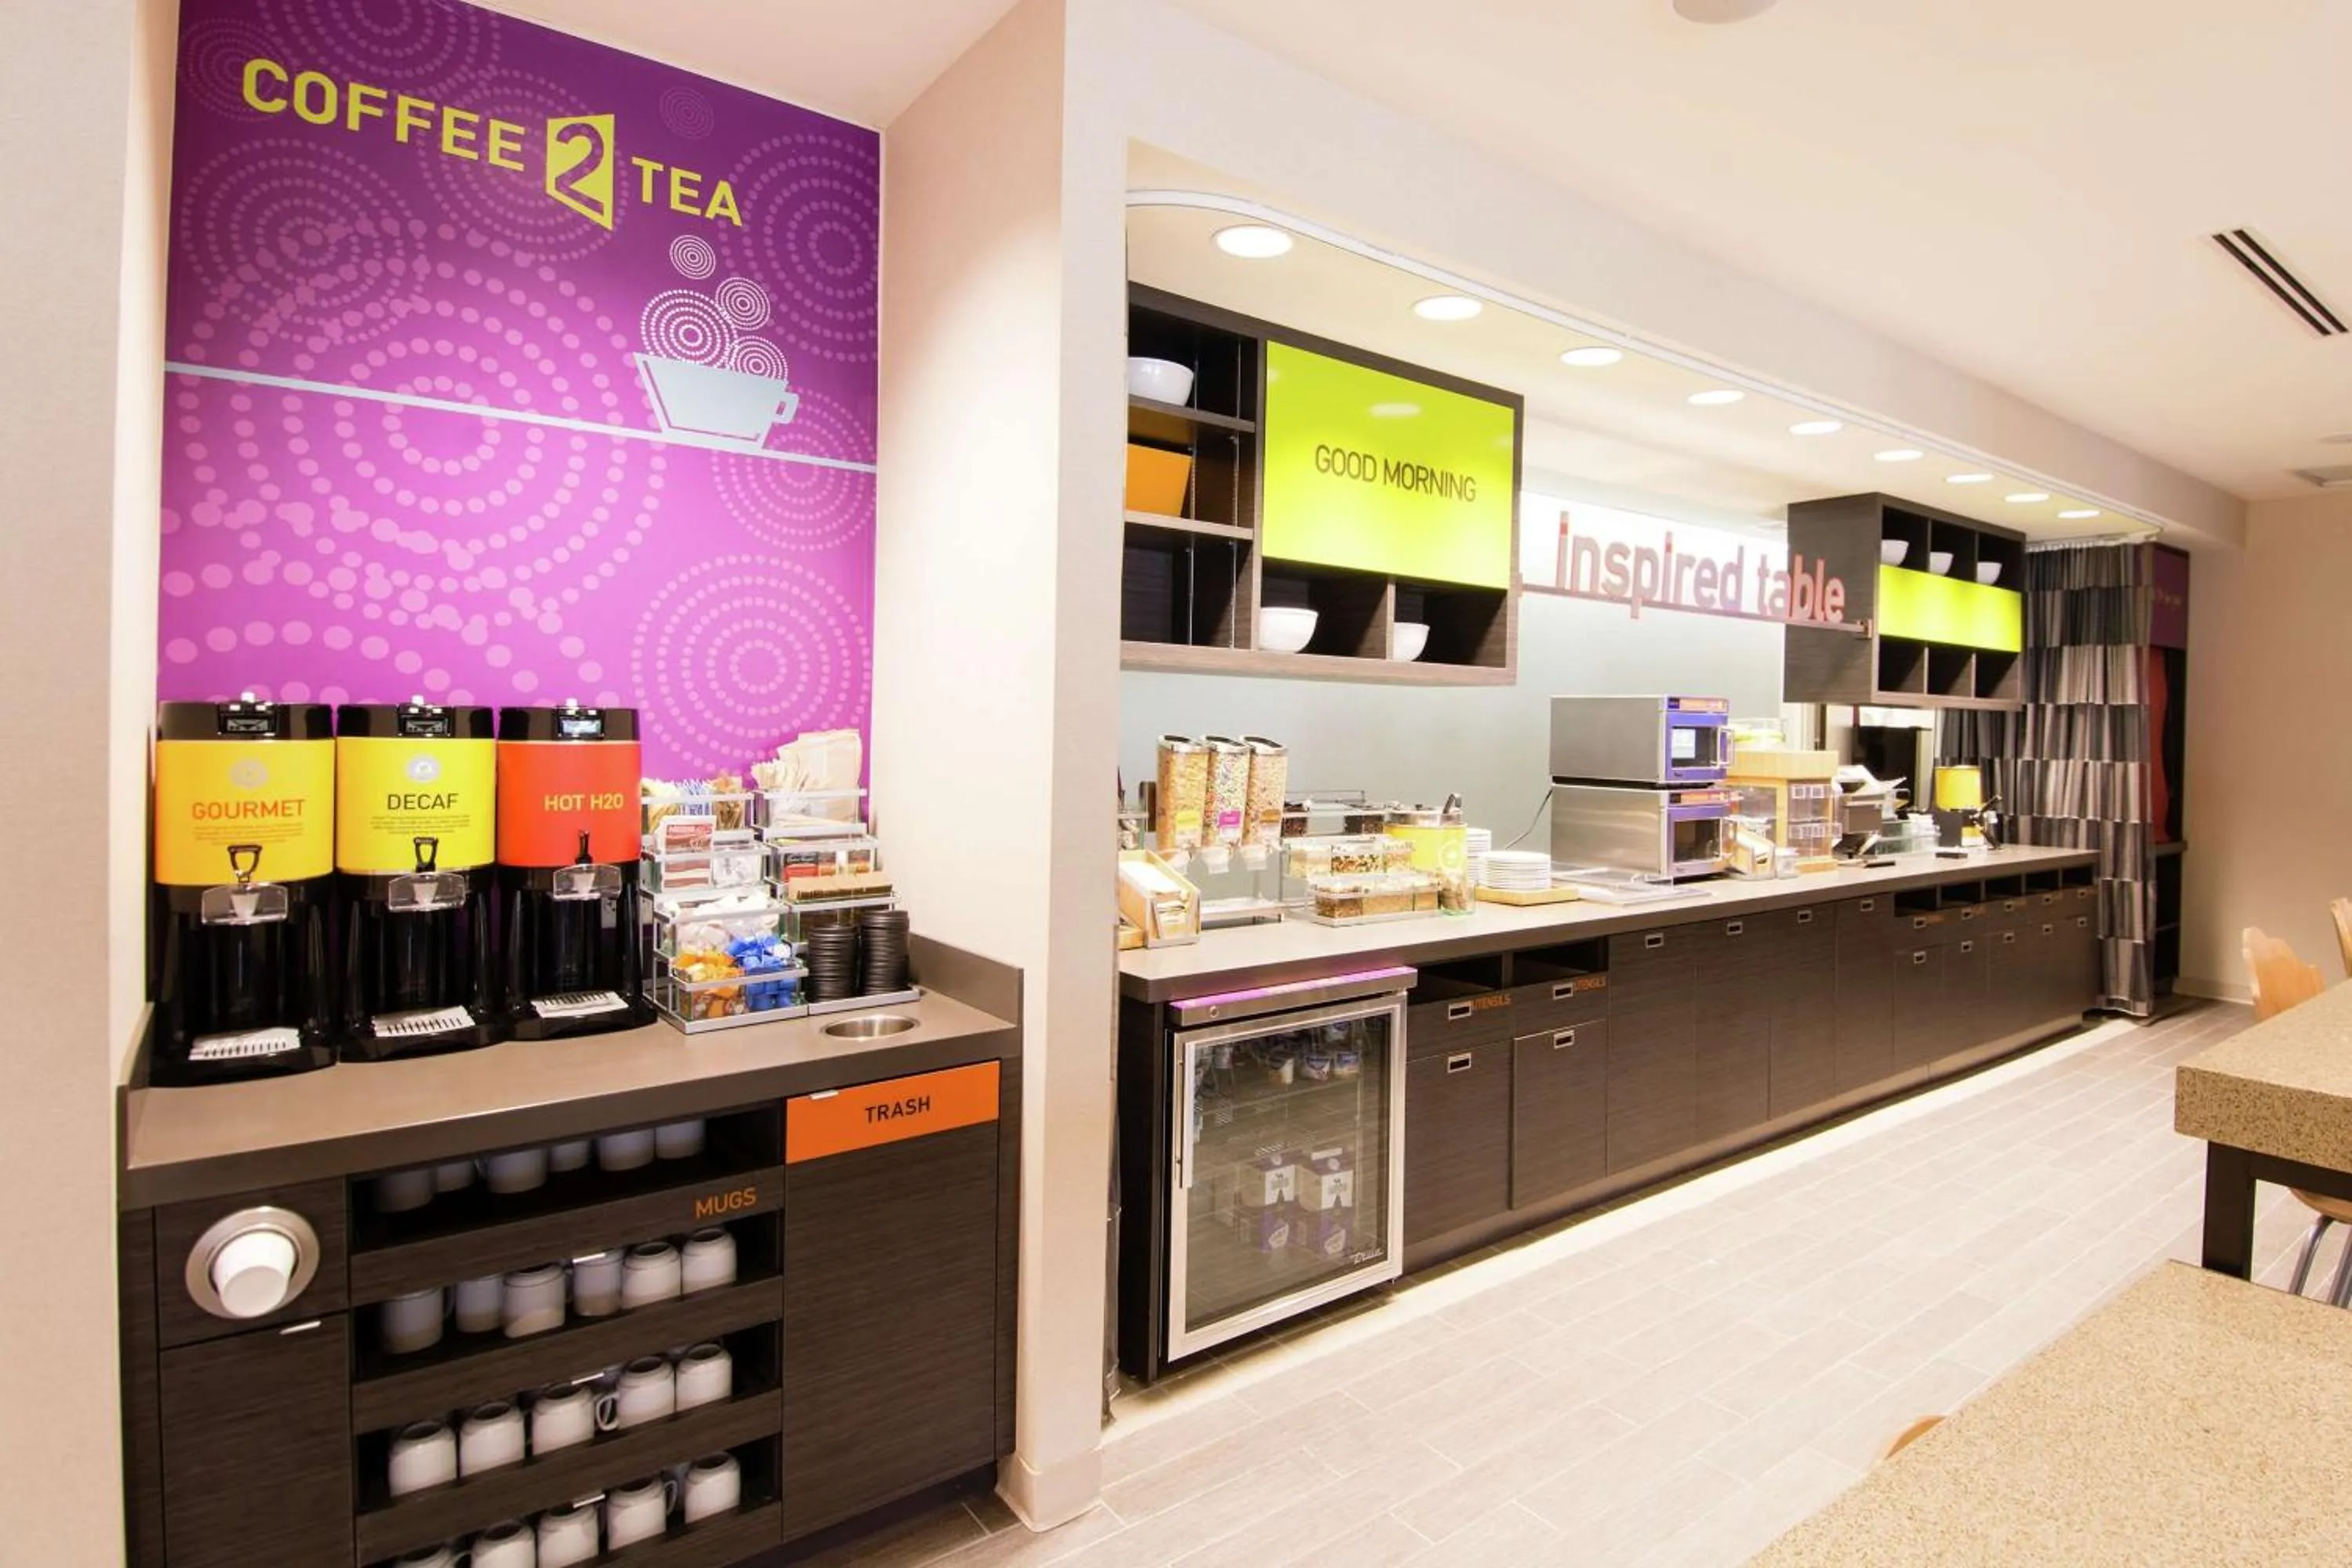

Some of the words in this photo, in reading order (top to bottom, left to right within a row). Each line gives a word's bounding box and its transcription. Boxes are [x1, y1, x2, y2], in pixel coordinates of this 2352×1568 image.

[242, 57, 525, 172] COFFEE
[554, 122, 604, 217] 2
[631, 156, 743, 227] TEA
[1315, 444, 1377, 483] GOOD
[1383, 458, 1476, 503] MORNING
[1555, 510, 1744, 619] inspired
[1757, 554, 1845, 622] table
[191, 798, 306, 820] GOURMET
[387, 793, 459, 811] DECAF
[543, 793, 586, 812] HOT
[865, 1095, 931, 1123] TRASH
[695, 1186, 757, 1219] MUGS
